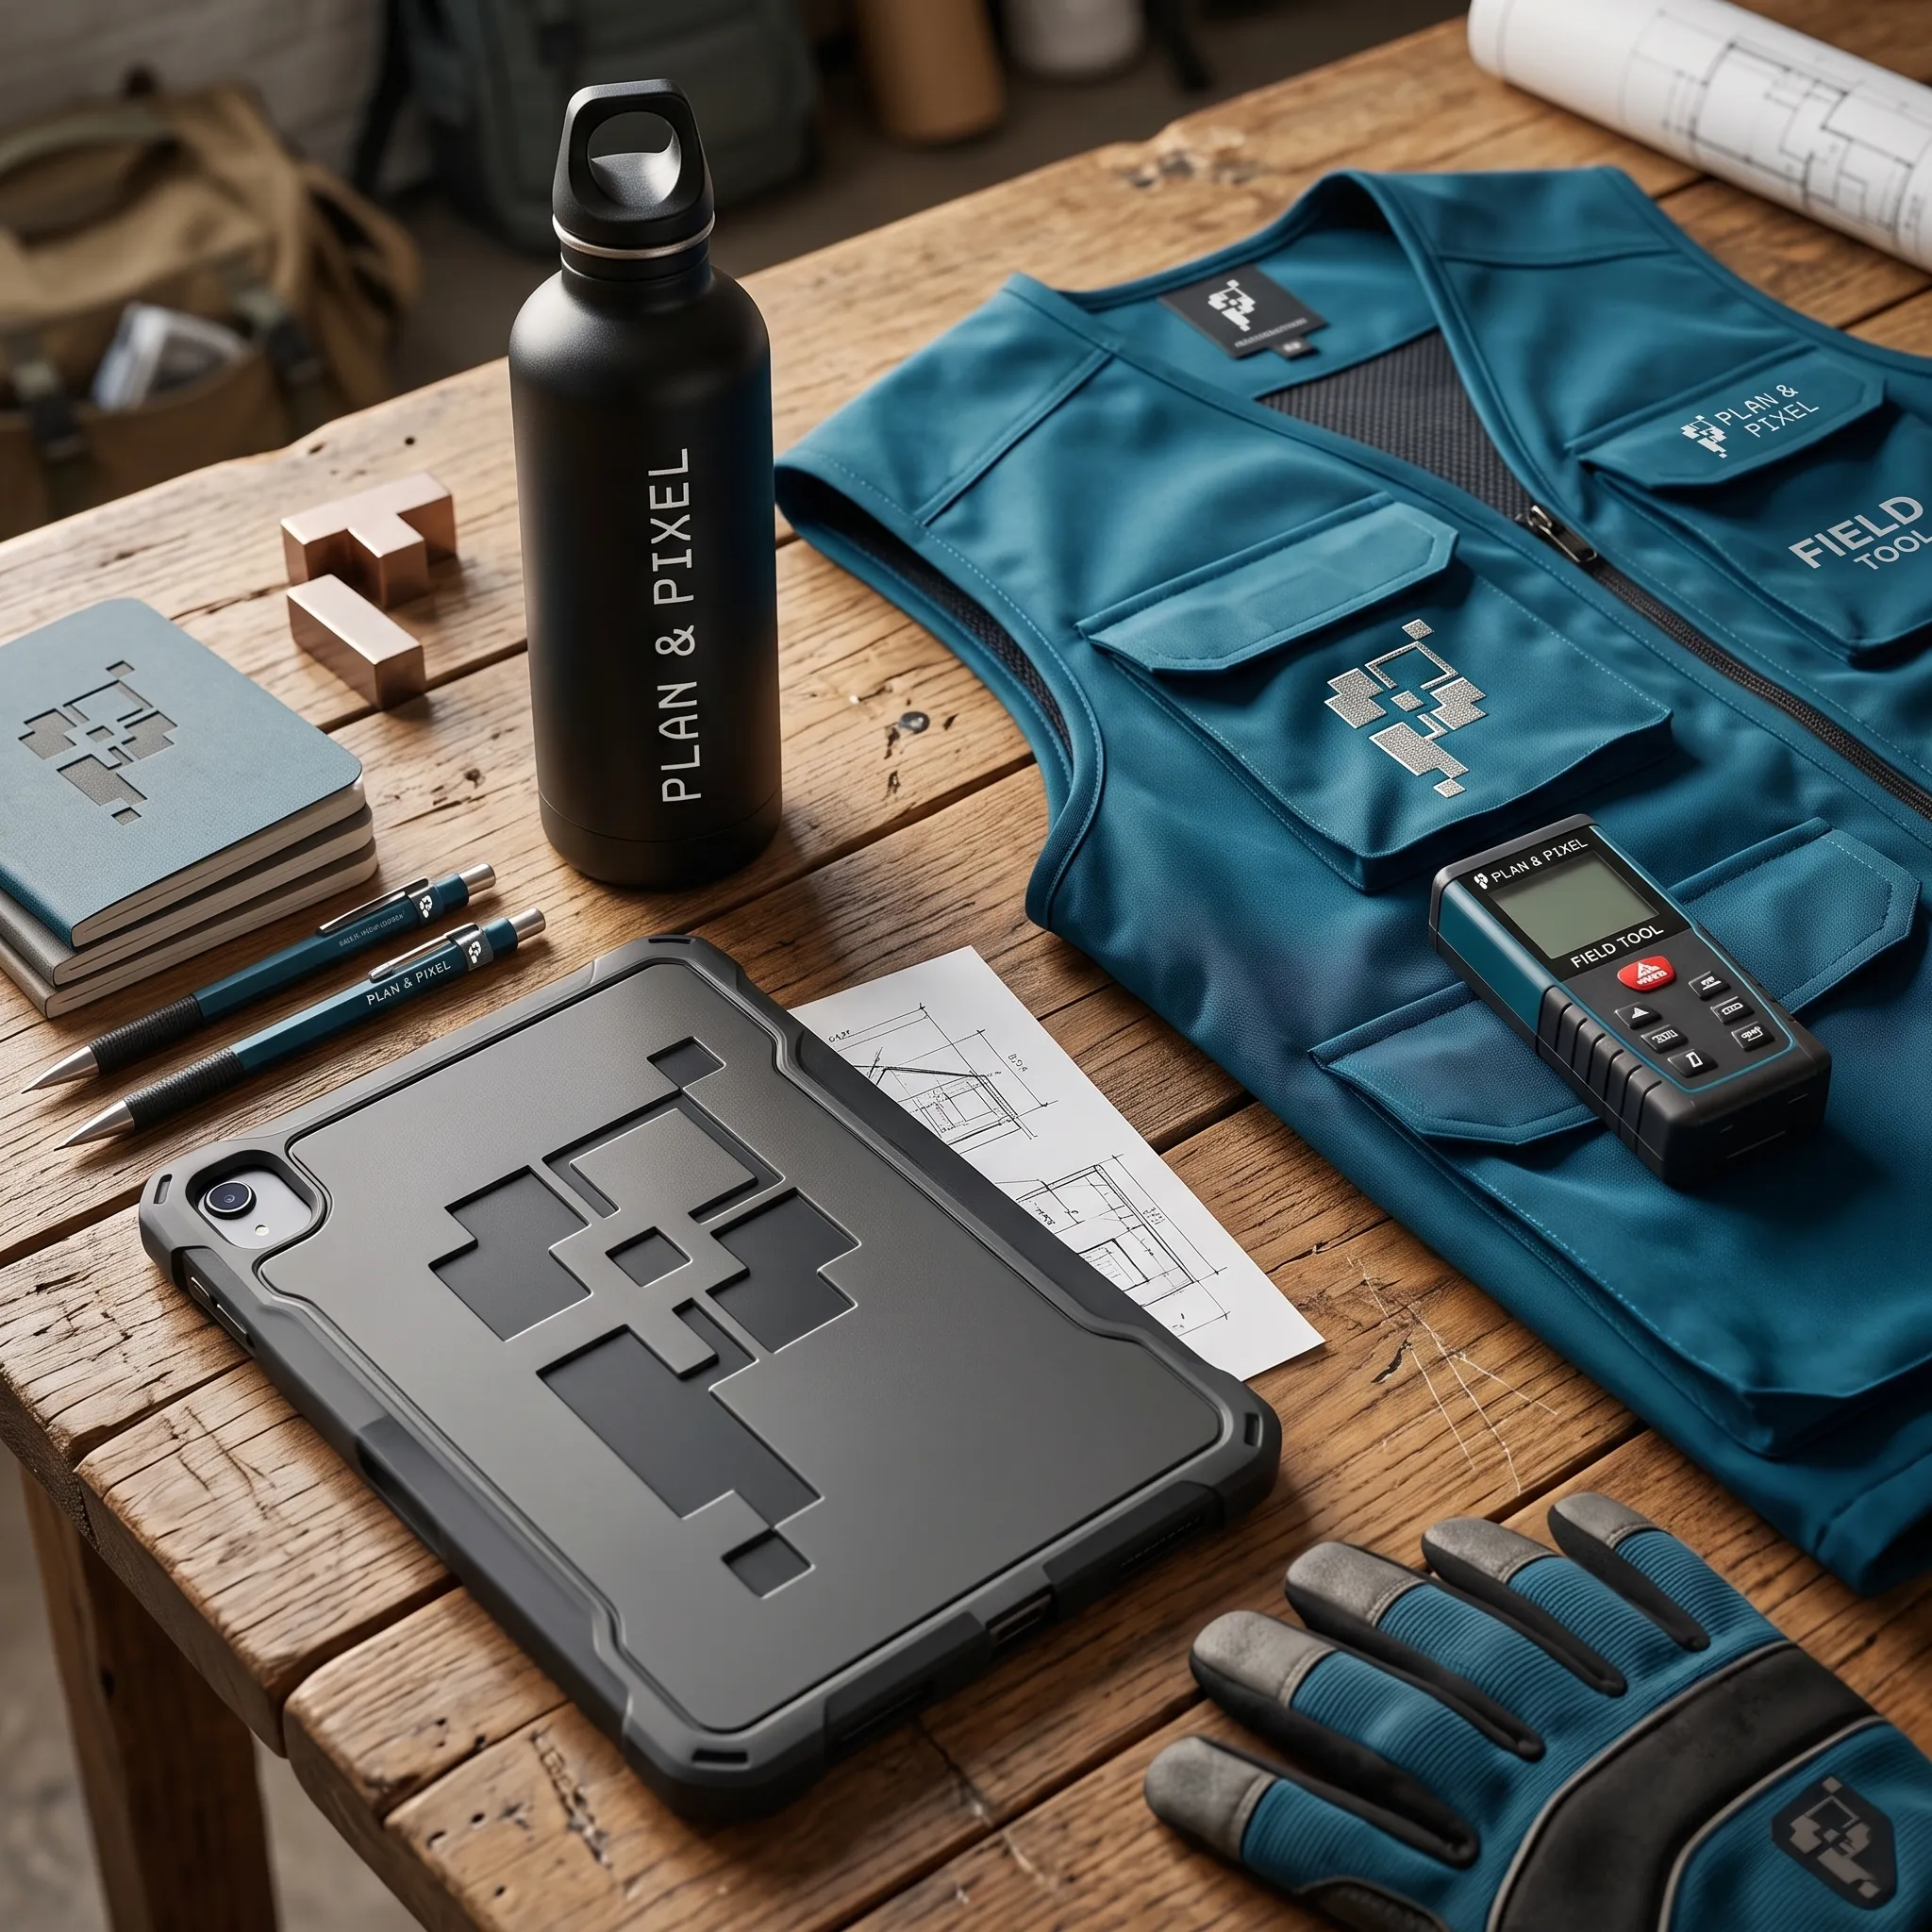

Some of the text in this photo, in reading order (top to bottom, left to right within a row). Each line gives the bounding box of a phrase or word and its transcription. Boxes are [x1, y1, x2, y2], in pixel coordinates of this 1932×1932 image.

[1714, 384, 1799, 426] PLAN &
[1743, 401, 1820, 438] PIXEL
[1788, 496, 1924, 570] FIELD
[1853, 529, 1932, 571] TOOL
[648, 448, 702, 803] PLAN & PIXEL
[1491, 839, 1589, 883] PLAN & PIXEL
[1570, 925, 1665, 969] FIELD TOOL
[366, 960, 452, 1006] PLAN & PIXEL
